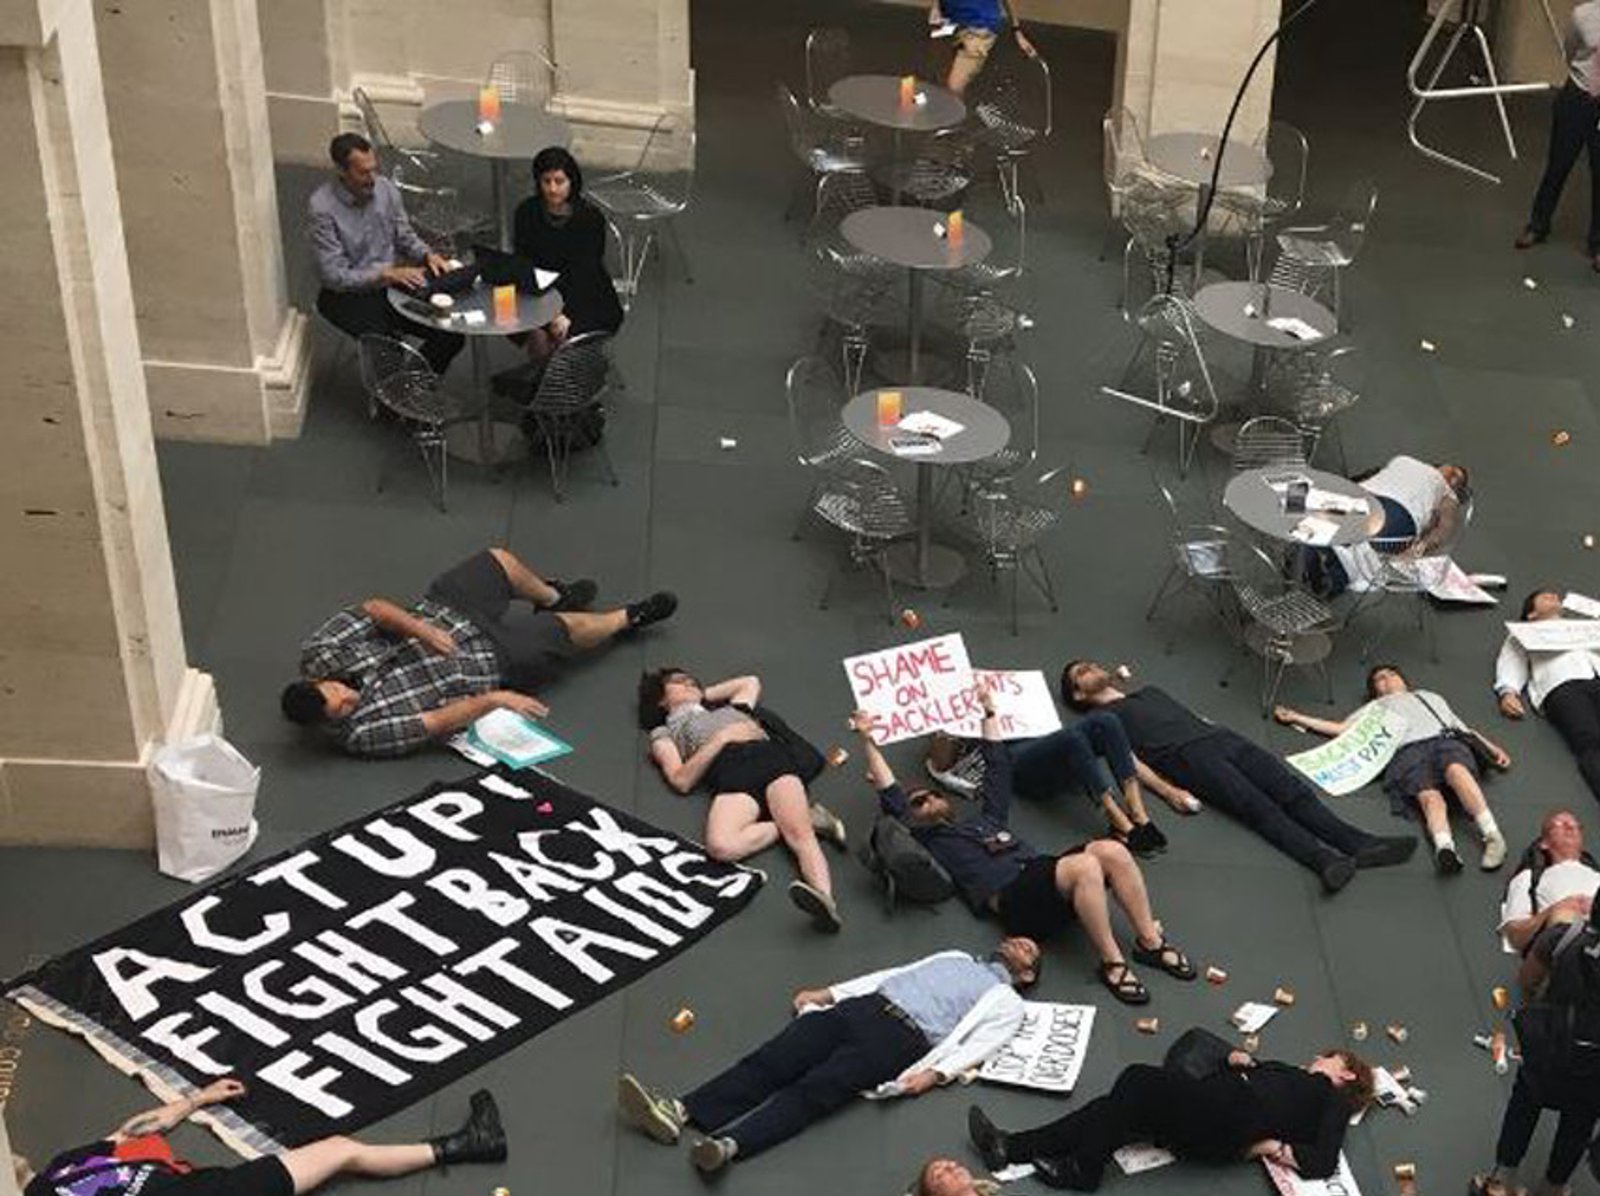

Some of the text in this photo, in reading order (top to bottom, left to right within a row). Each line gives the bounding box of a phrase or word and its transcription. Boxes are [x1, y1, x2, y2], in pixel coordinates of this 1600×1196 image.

[853, 642, 955, 696] SHAME
[895, 681, 928, 707] ON
[1357, 726, 1392, 762] PAY
[92, 850, 347, 1022] ACT
[141, 807, 674, 1075] FIGHT BACK
[257, 855, 750, 1120] FIGHT AIDS
